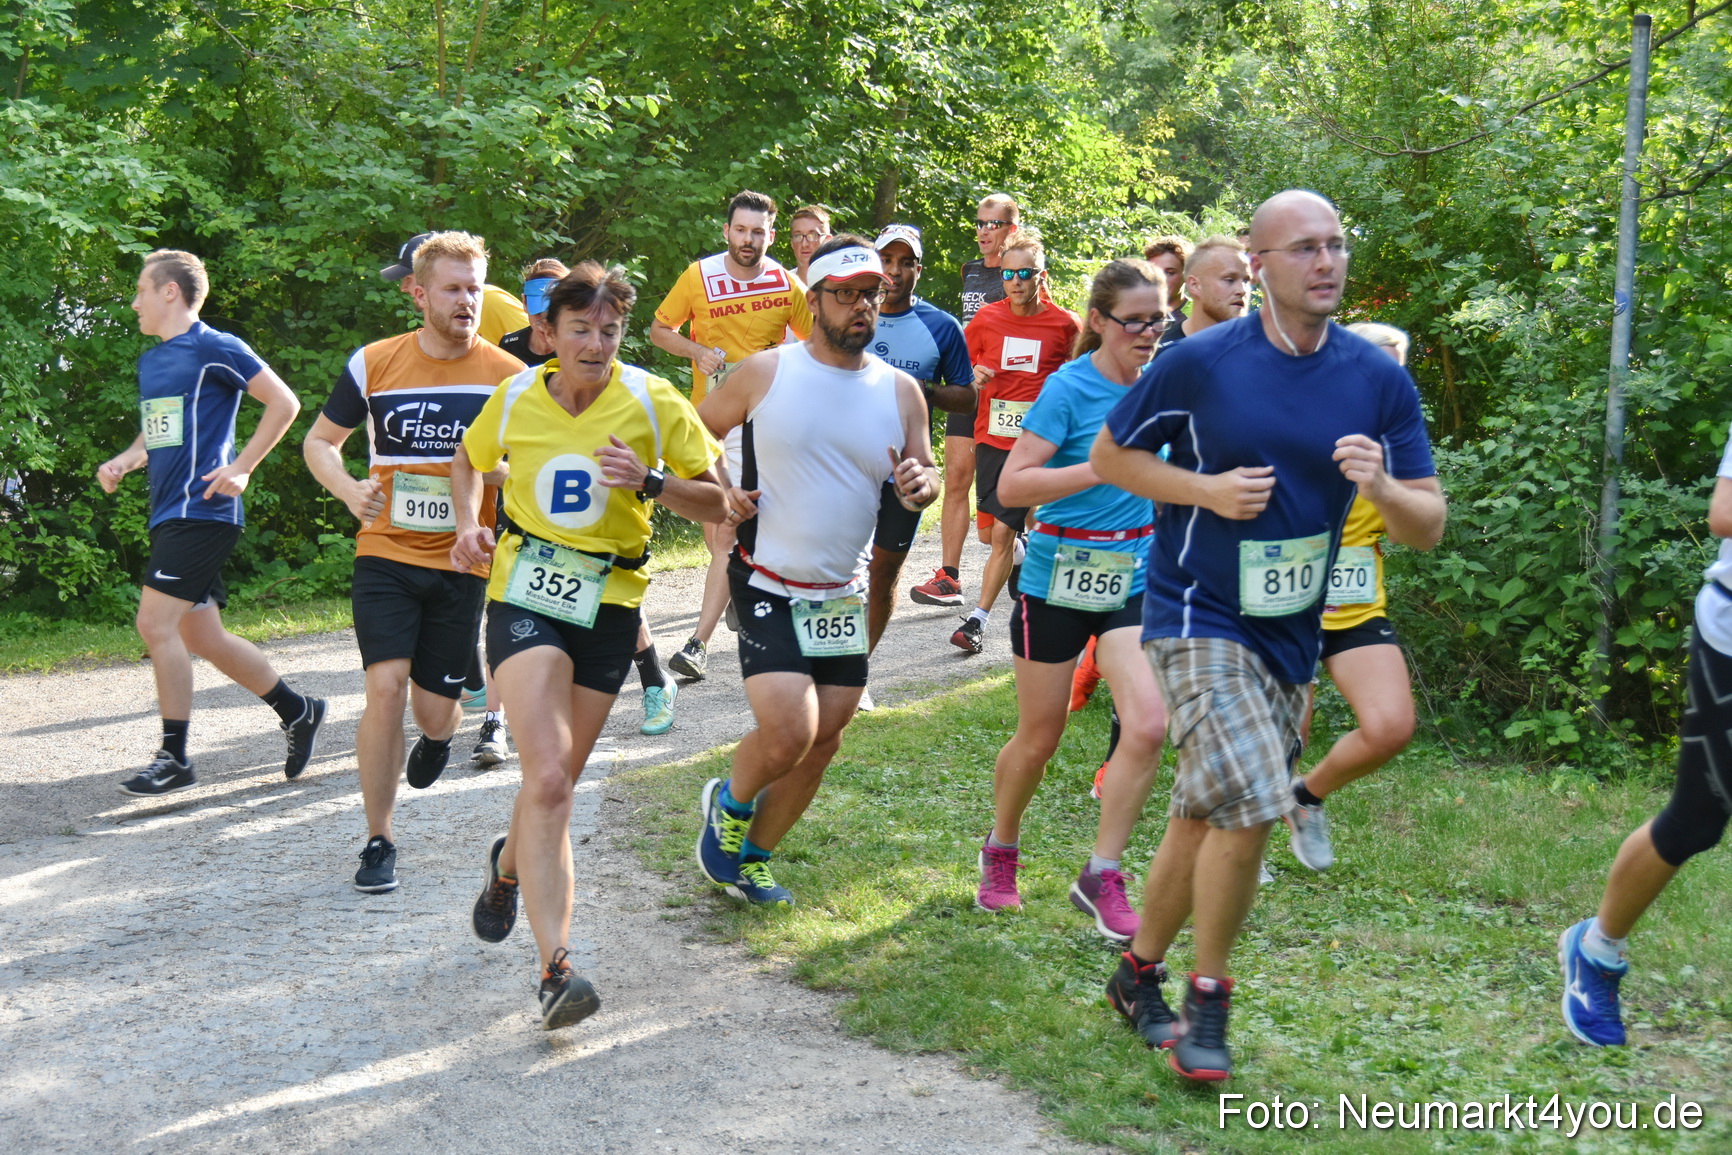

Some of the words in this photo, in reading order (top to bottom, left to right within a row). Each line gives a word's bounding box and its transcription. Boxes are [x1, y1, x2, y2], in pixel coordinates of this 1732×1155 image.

[709, 303, 747, 319] MAX
[751, 296, 792, 312] BÖGL
[147, 416, 169, 435] 815
[998, 413, 1023, 428] 528
[550, 470, 592, 514] B
[406, 499, 449, 520] 9109
[529, 566, 582, 603] 352
[1064, 568, 1122, 595] 1856
[1264, 564, 1313, 595] 810
[1331, 568, 1367, 588] 670
[525, 589, 561, 606] Miesbauer
[561, 601, 577, 611] Elke
[803, 615, 856, 640] 1855
